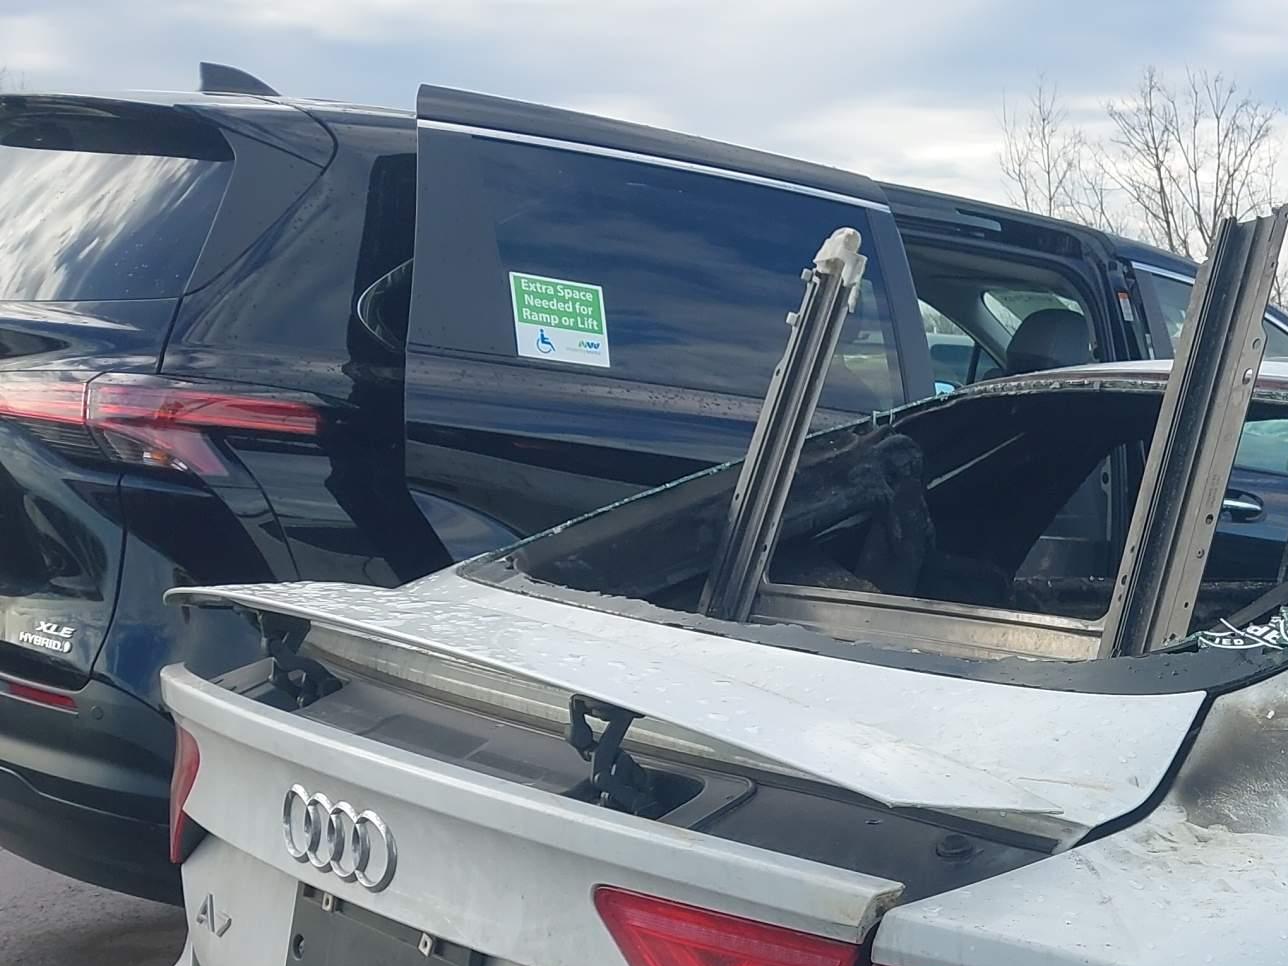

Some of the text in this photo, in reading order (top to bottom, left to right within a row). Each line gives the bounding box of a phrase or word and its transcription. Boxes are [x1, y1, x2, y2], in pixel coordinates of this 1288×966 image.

[521, 279, 593, 301] Extra Space
[524, 294, 593, 315] Needed for
[523, 308, 599, 330] Ramp or Lift
[36, 621, 75, 638] XLE
[19, 632, 63, 652] HYBRID
[196, 894, 232, 938] A7
